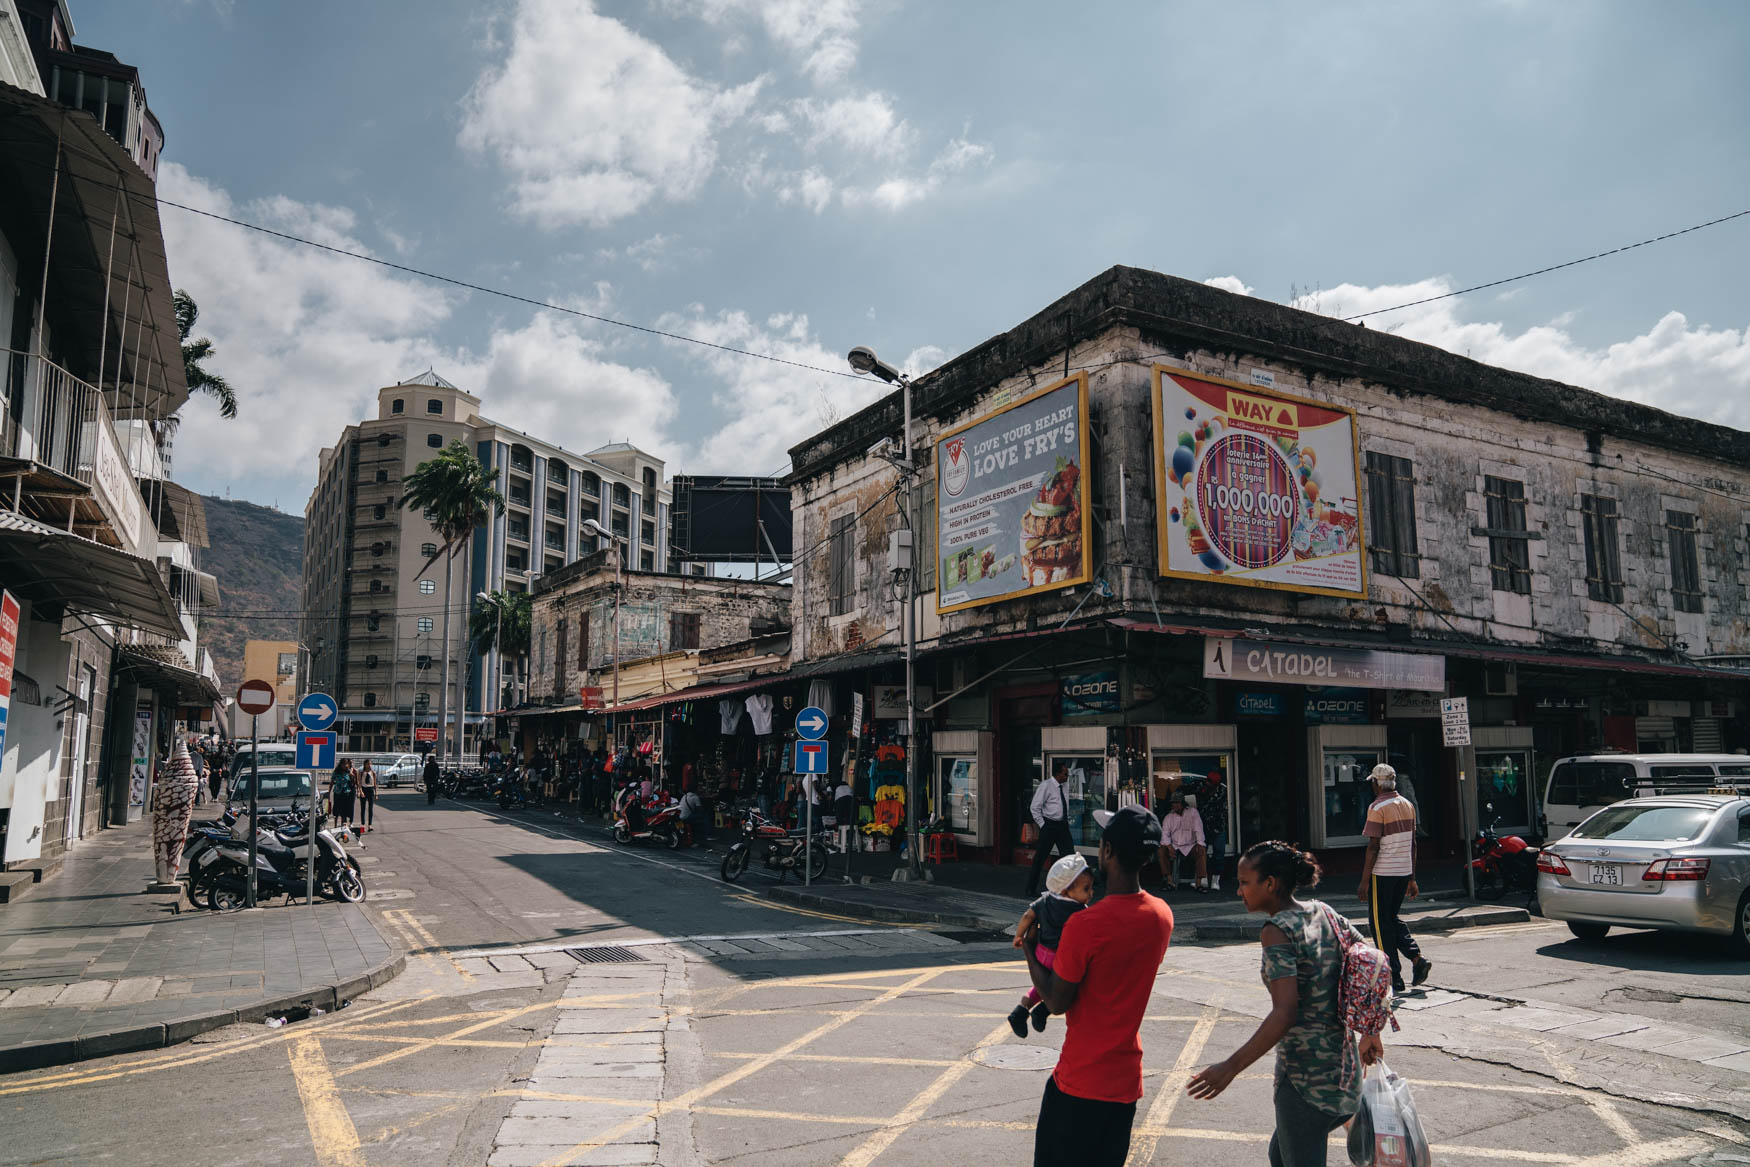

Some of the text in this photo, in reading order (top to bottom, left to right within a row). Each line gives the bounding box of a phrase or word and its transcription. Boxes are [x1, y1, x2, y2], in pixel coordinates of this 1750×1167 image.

[1232, 398, 1273, 422] WAY
[974, 405, 1074, 456] LOVE YOUR HEART
[974, 422, 1075, 478] LOVE FRY'S
[1227, 449, 1250, 459] loterie
[1226, 457, 1269, 468] anniversaire
[1240, 472, 1265, 483] gagner
[949, 481, 1033, 514] NATURALLY CHOLESTEROL FREE
[1206, 483, 1293, 518] 1,000,000
[970, 510, 991, 523] PROTEIN
[1232, 514, 1250, 524] BONS
[950, 527, 989, 544] 100% PURE VEG
[1072, 681, 1117, 696] OZONE
[1317, 700, 1365, 711] OZONE
[1595, 865, 1616, 876] 7135
[1593, 875, 1617, 885] CZ 13
